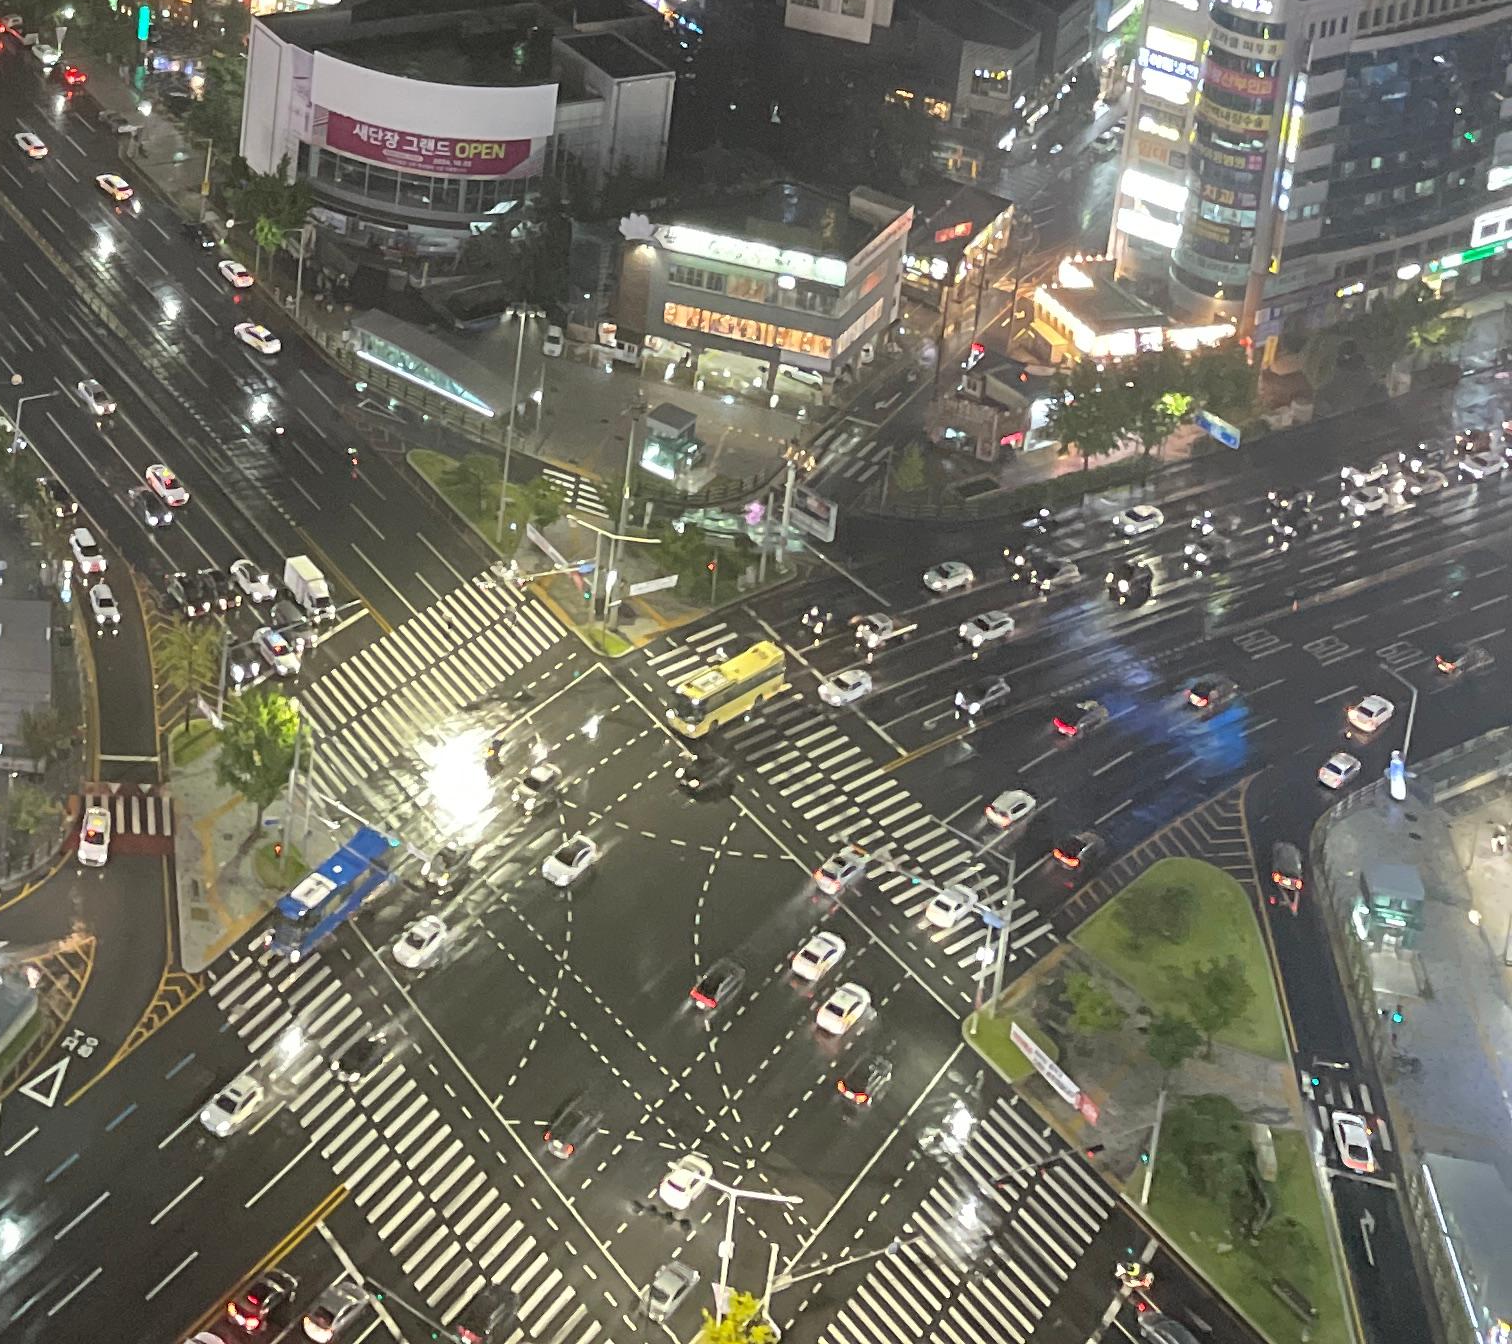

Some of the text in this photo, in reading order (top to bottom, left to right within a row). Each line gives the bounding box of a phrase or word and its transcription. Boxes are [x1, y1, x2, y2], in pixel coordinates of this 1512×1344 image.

[353, 123, 400, 149] 새단장
[403, 135, 451, 156] 그랜드
[455, 142, 506, 160] OPEN
